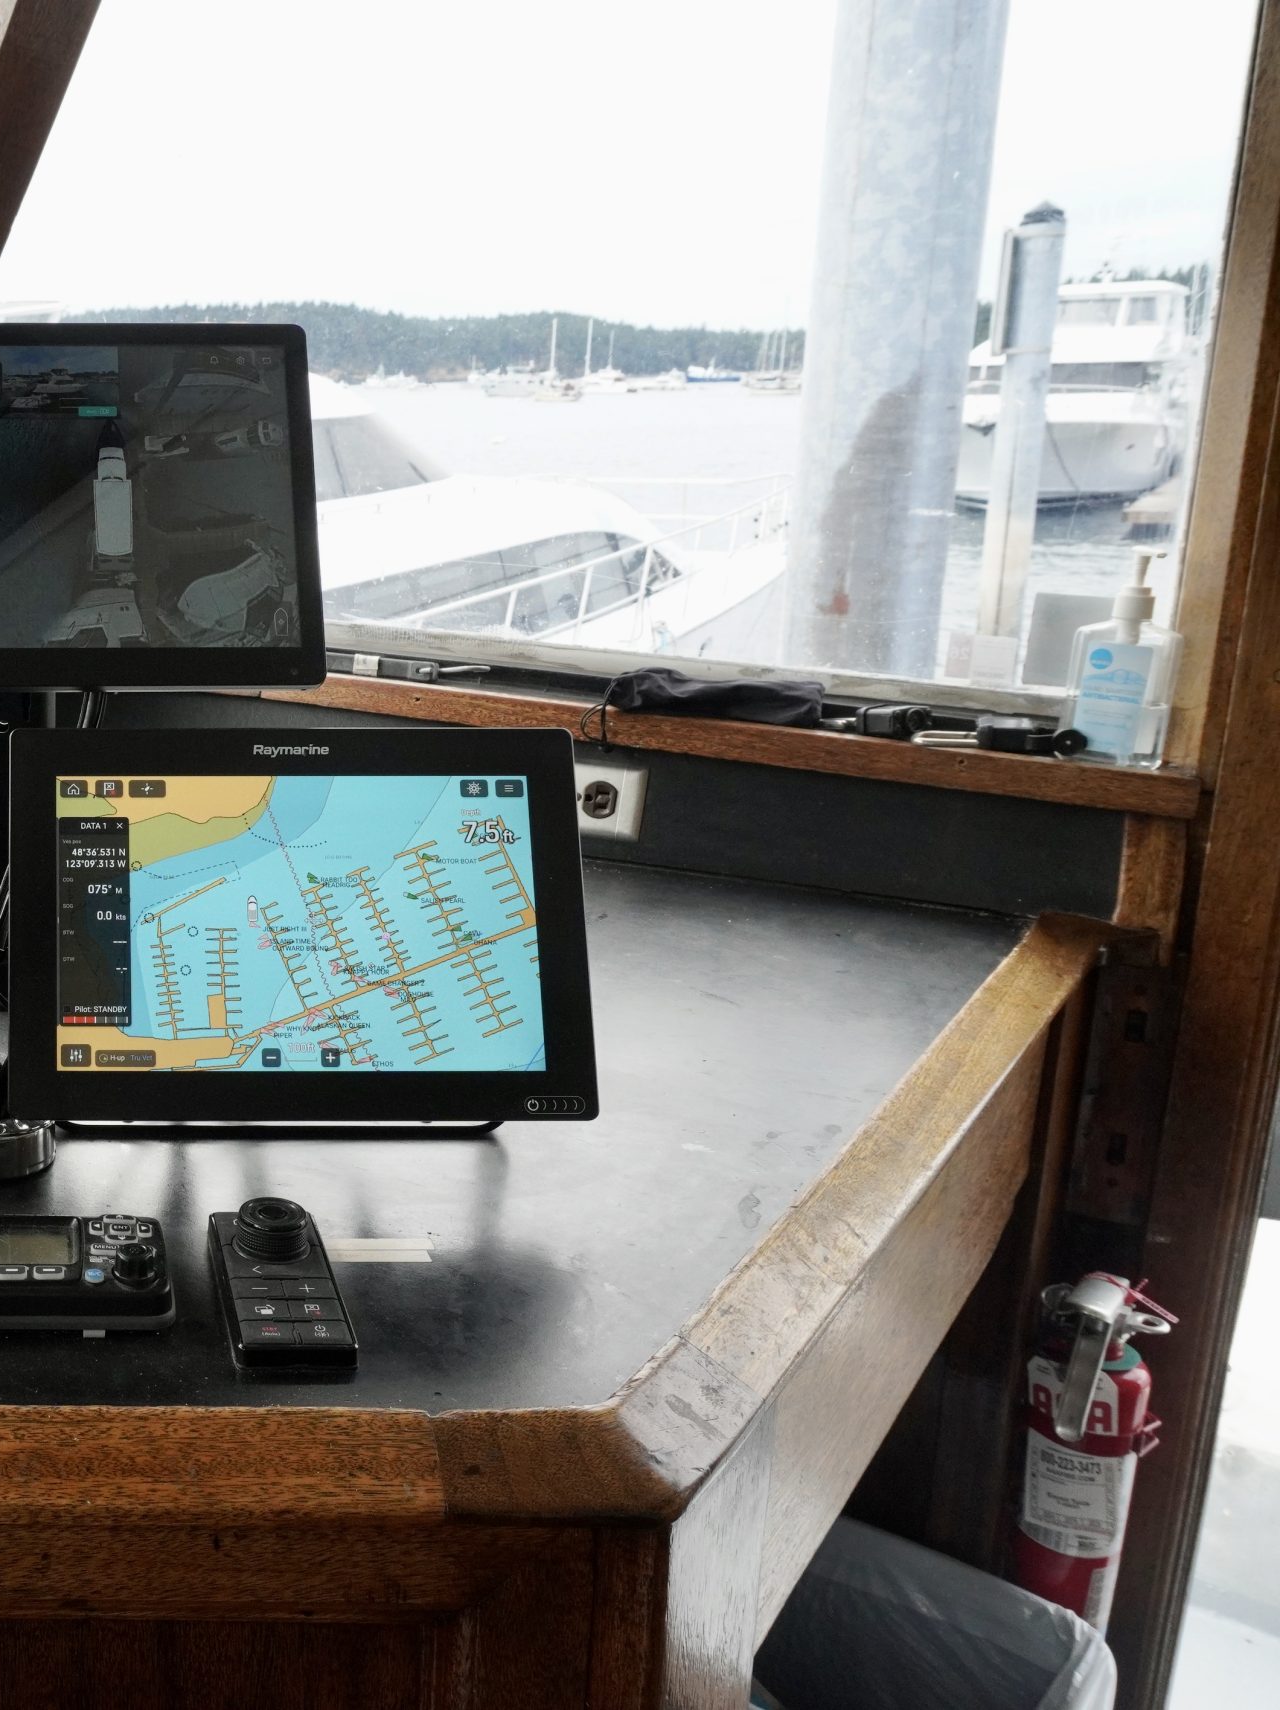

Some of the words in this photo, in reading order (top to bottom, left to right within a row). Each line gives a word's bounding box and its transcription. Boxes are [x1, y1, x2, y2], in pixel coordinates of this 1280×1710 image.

[253, 744, 330, 758] Raymarine
[462, 808, 481, 816] Depth
[80, 822, 101, 830] DATA
[102, 822, 108, 830] 1
[462, 820, 501, 843] 7.5
[502, 829, 515, 844] ft
[118, 848, 126, 856] N
[117, 860, 126, 868] W
[96, 911, 112, 921] 0.0
[110, 1055, 126, 1063] H-up
